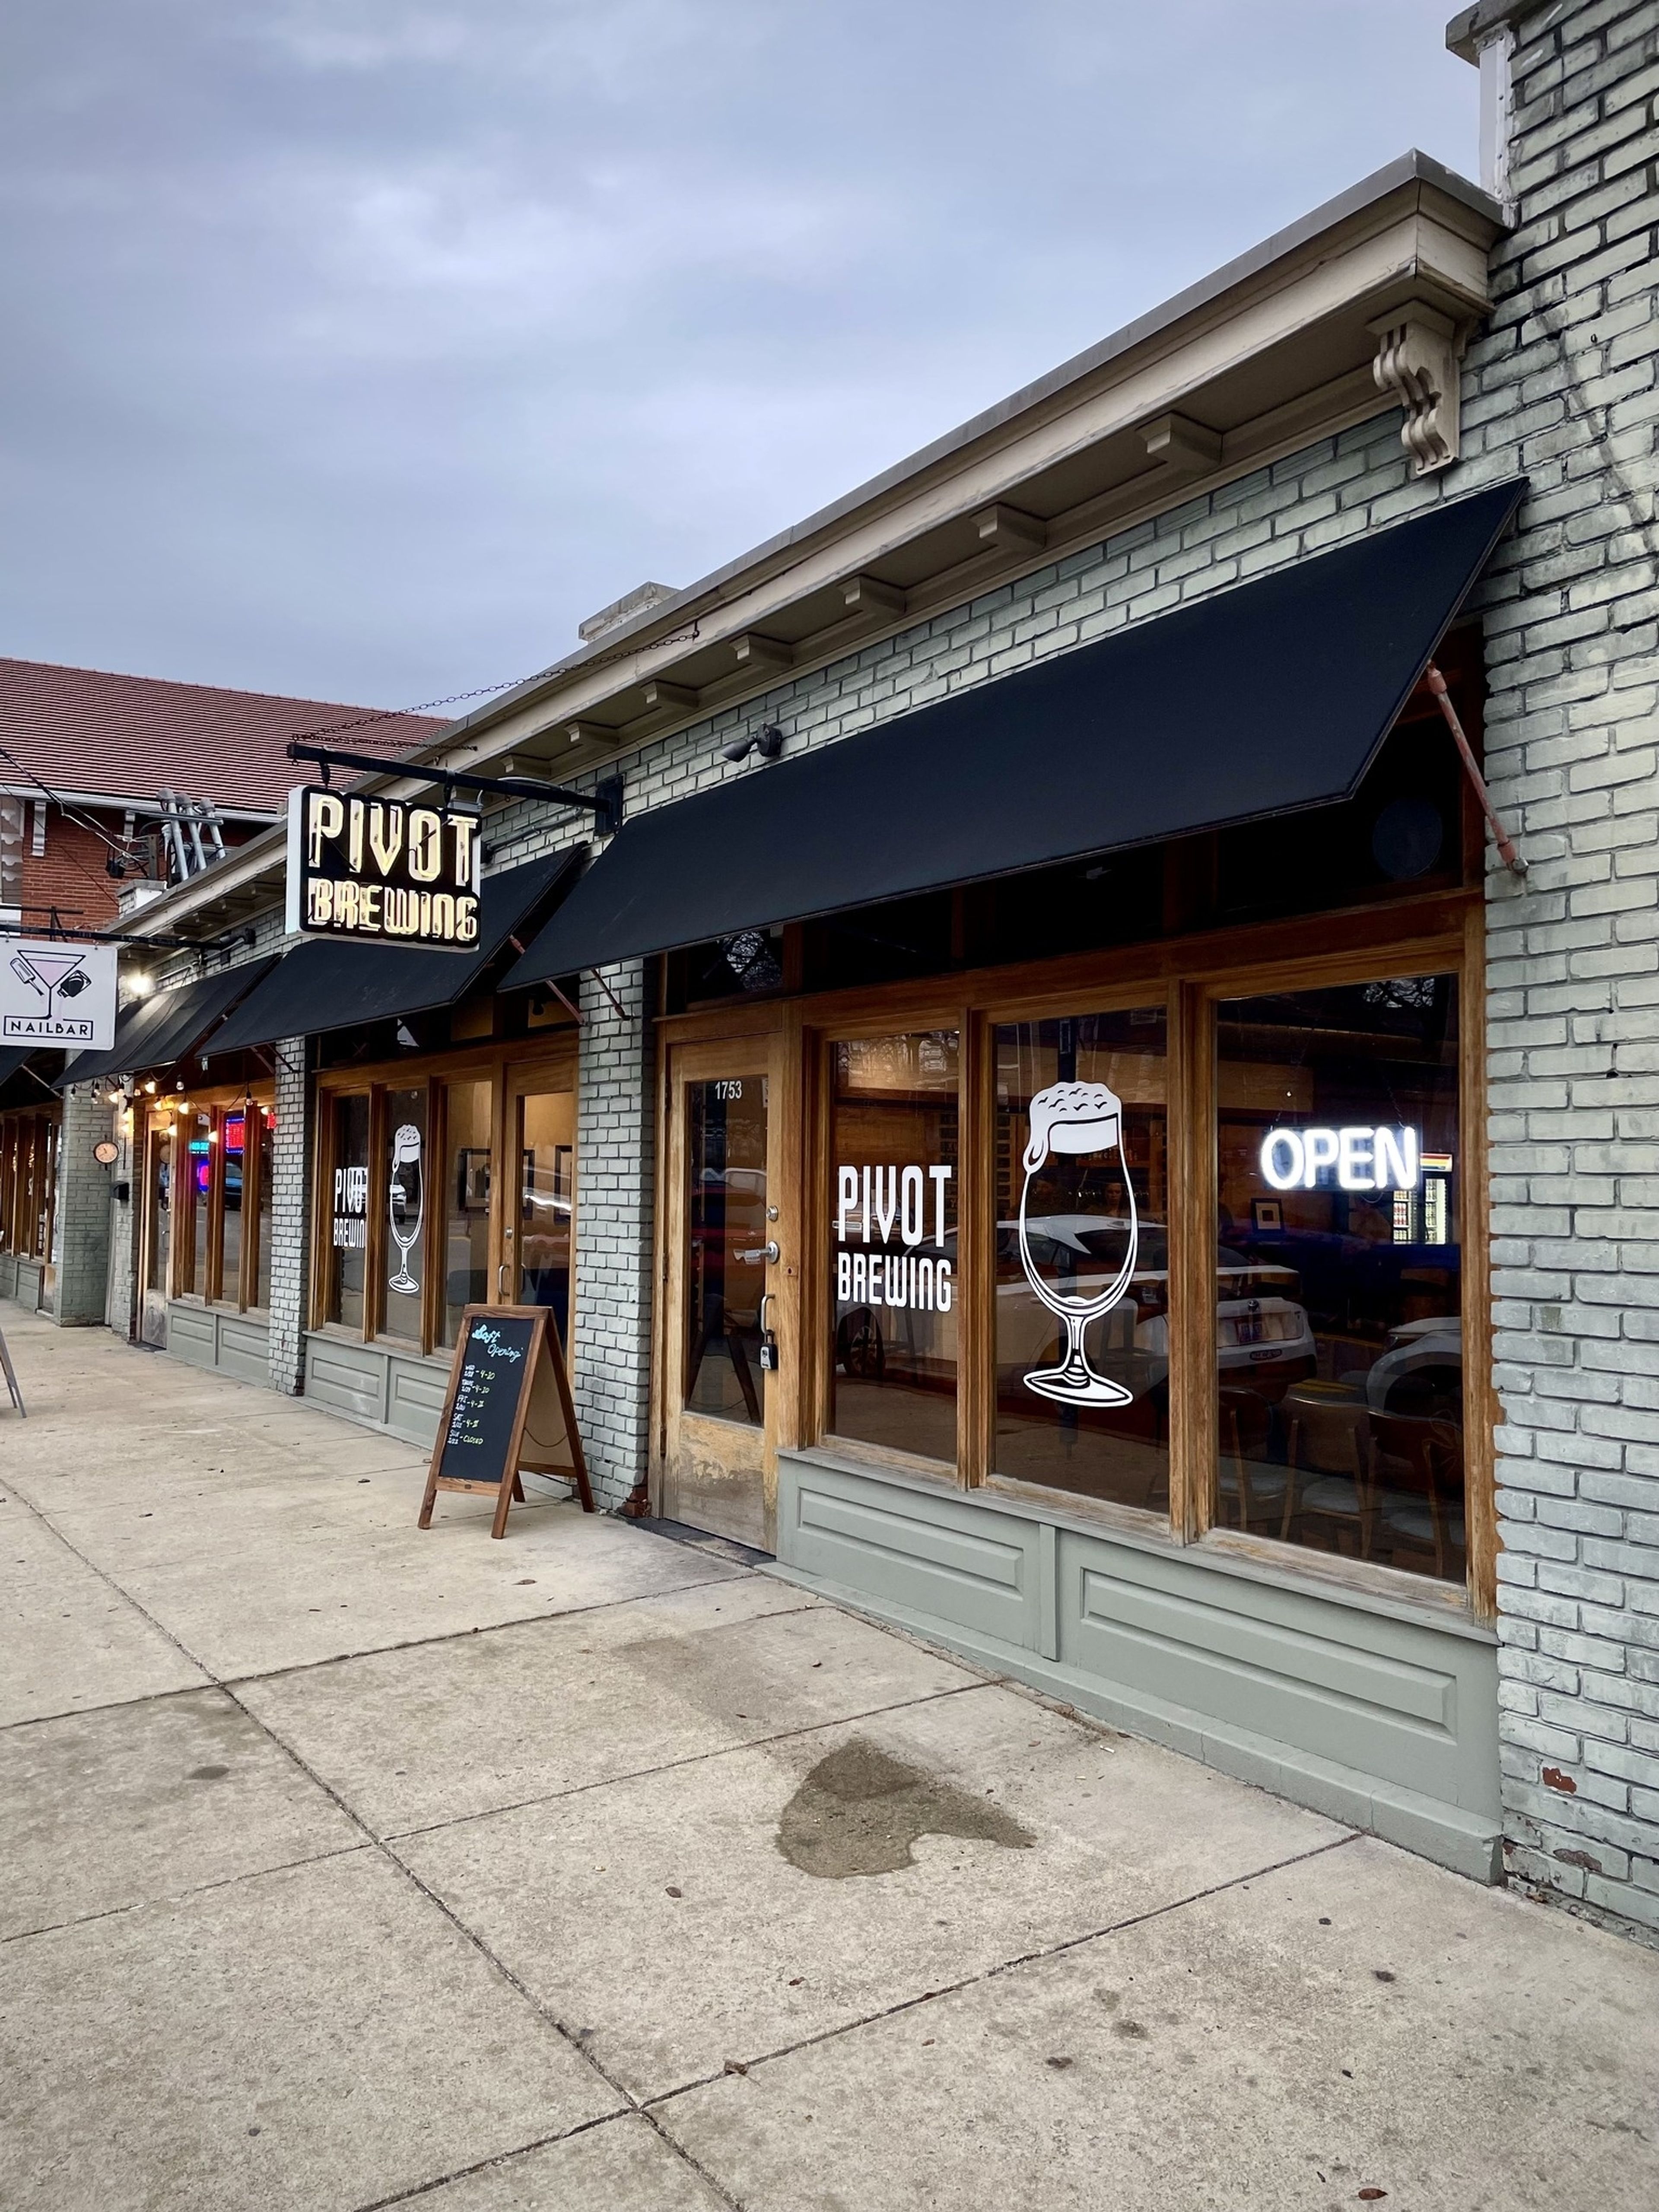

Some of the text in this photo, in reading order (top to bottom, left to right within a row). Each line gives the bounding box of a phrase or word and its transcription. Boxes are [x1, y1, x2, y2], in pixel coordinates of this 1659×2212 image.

[309, 792, 478, 886] PIVOT
[308, 877, 477, 941] BREWING
[715, 1080, 742, 1100] 1753
[1261, 1126, 1417, 1189] OPEN
[334, 1218, 367, 1248] BREWIN
[838, 1165, 952, 1247] PIVOT
[838, 1252, 951, 1312] BREWING
